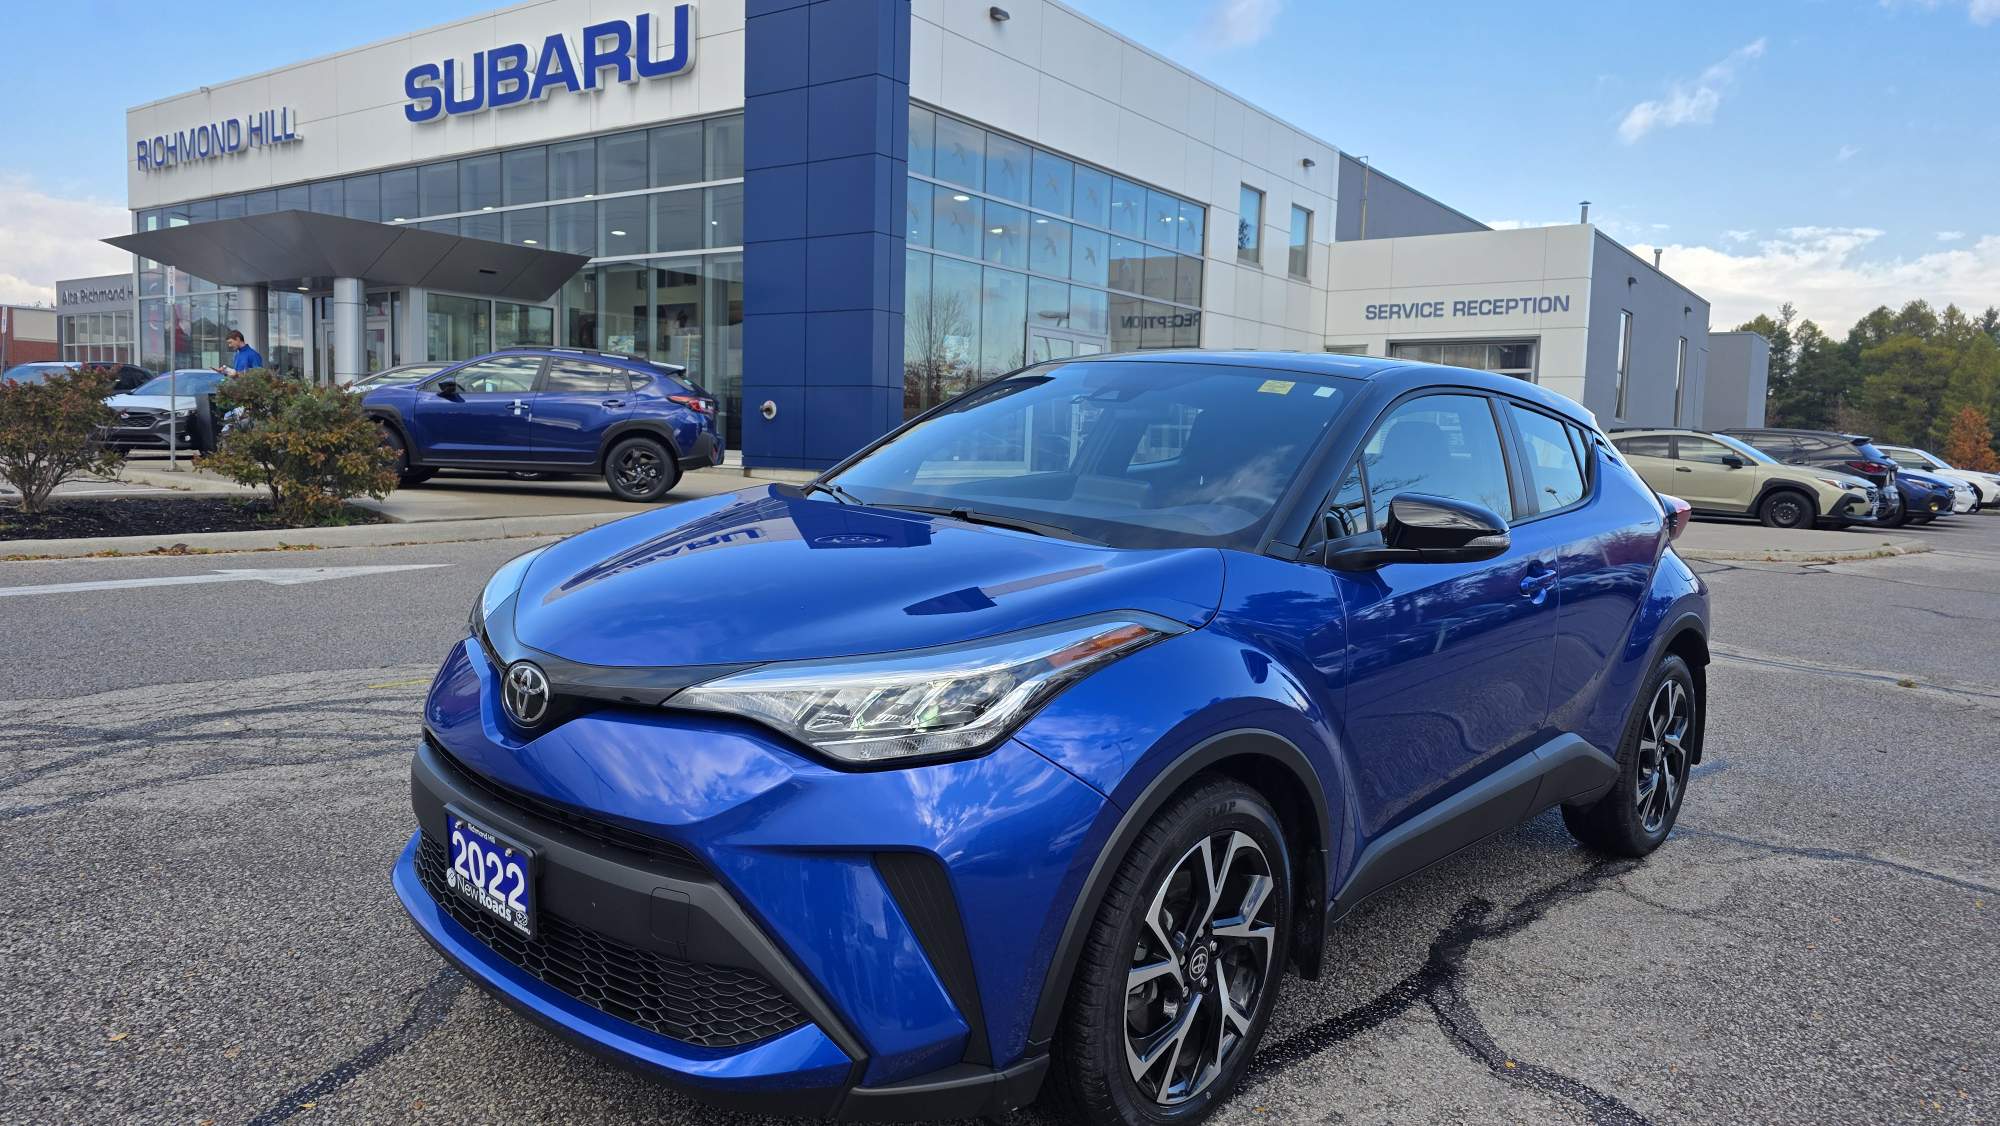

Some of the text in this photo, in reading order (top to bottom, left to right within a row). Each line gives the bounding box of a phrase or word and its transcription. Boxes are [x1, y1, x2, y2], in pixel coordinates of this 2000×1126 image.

[404, 4, 692, 123] SUBARU
[137, 106, 296, 171] RICHMOND HILL
[81, 286, 125, 304] Richmond
[1365, 295, 1570, 320] SERVICE RECEPTION
[452, 831, 526, 912] 2022
